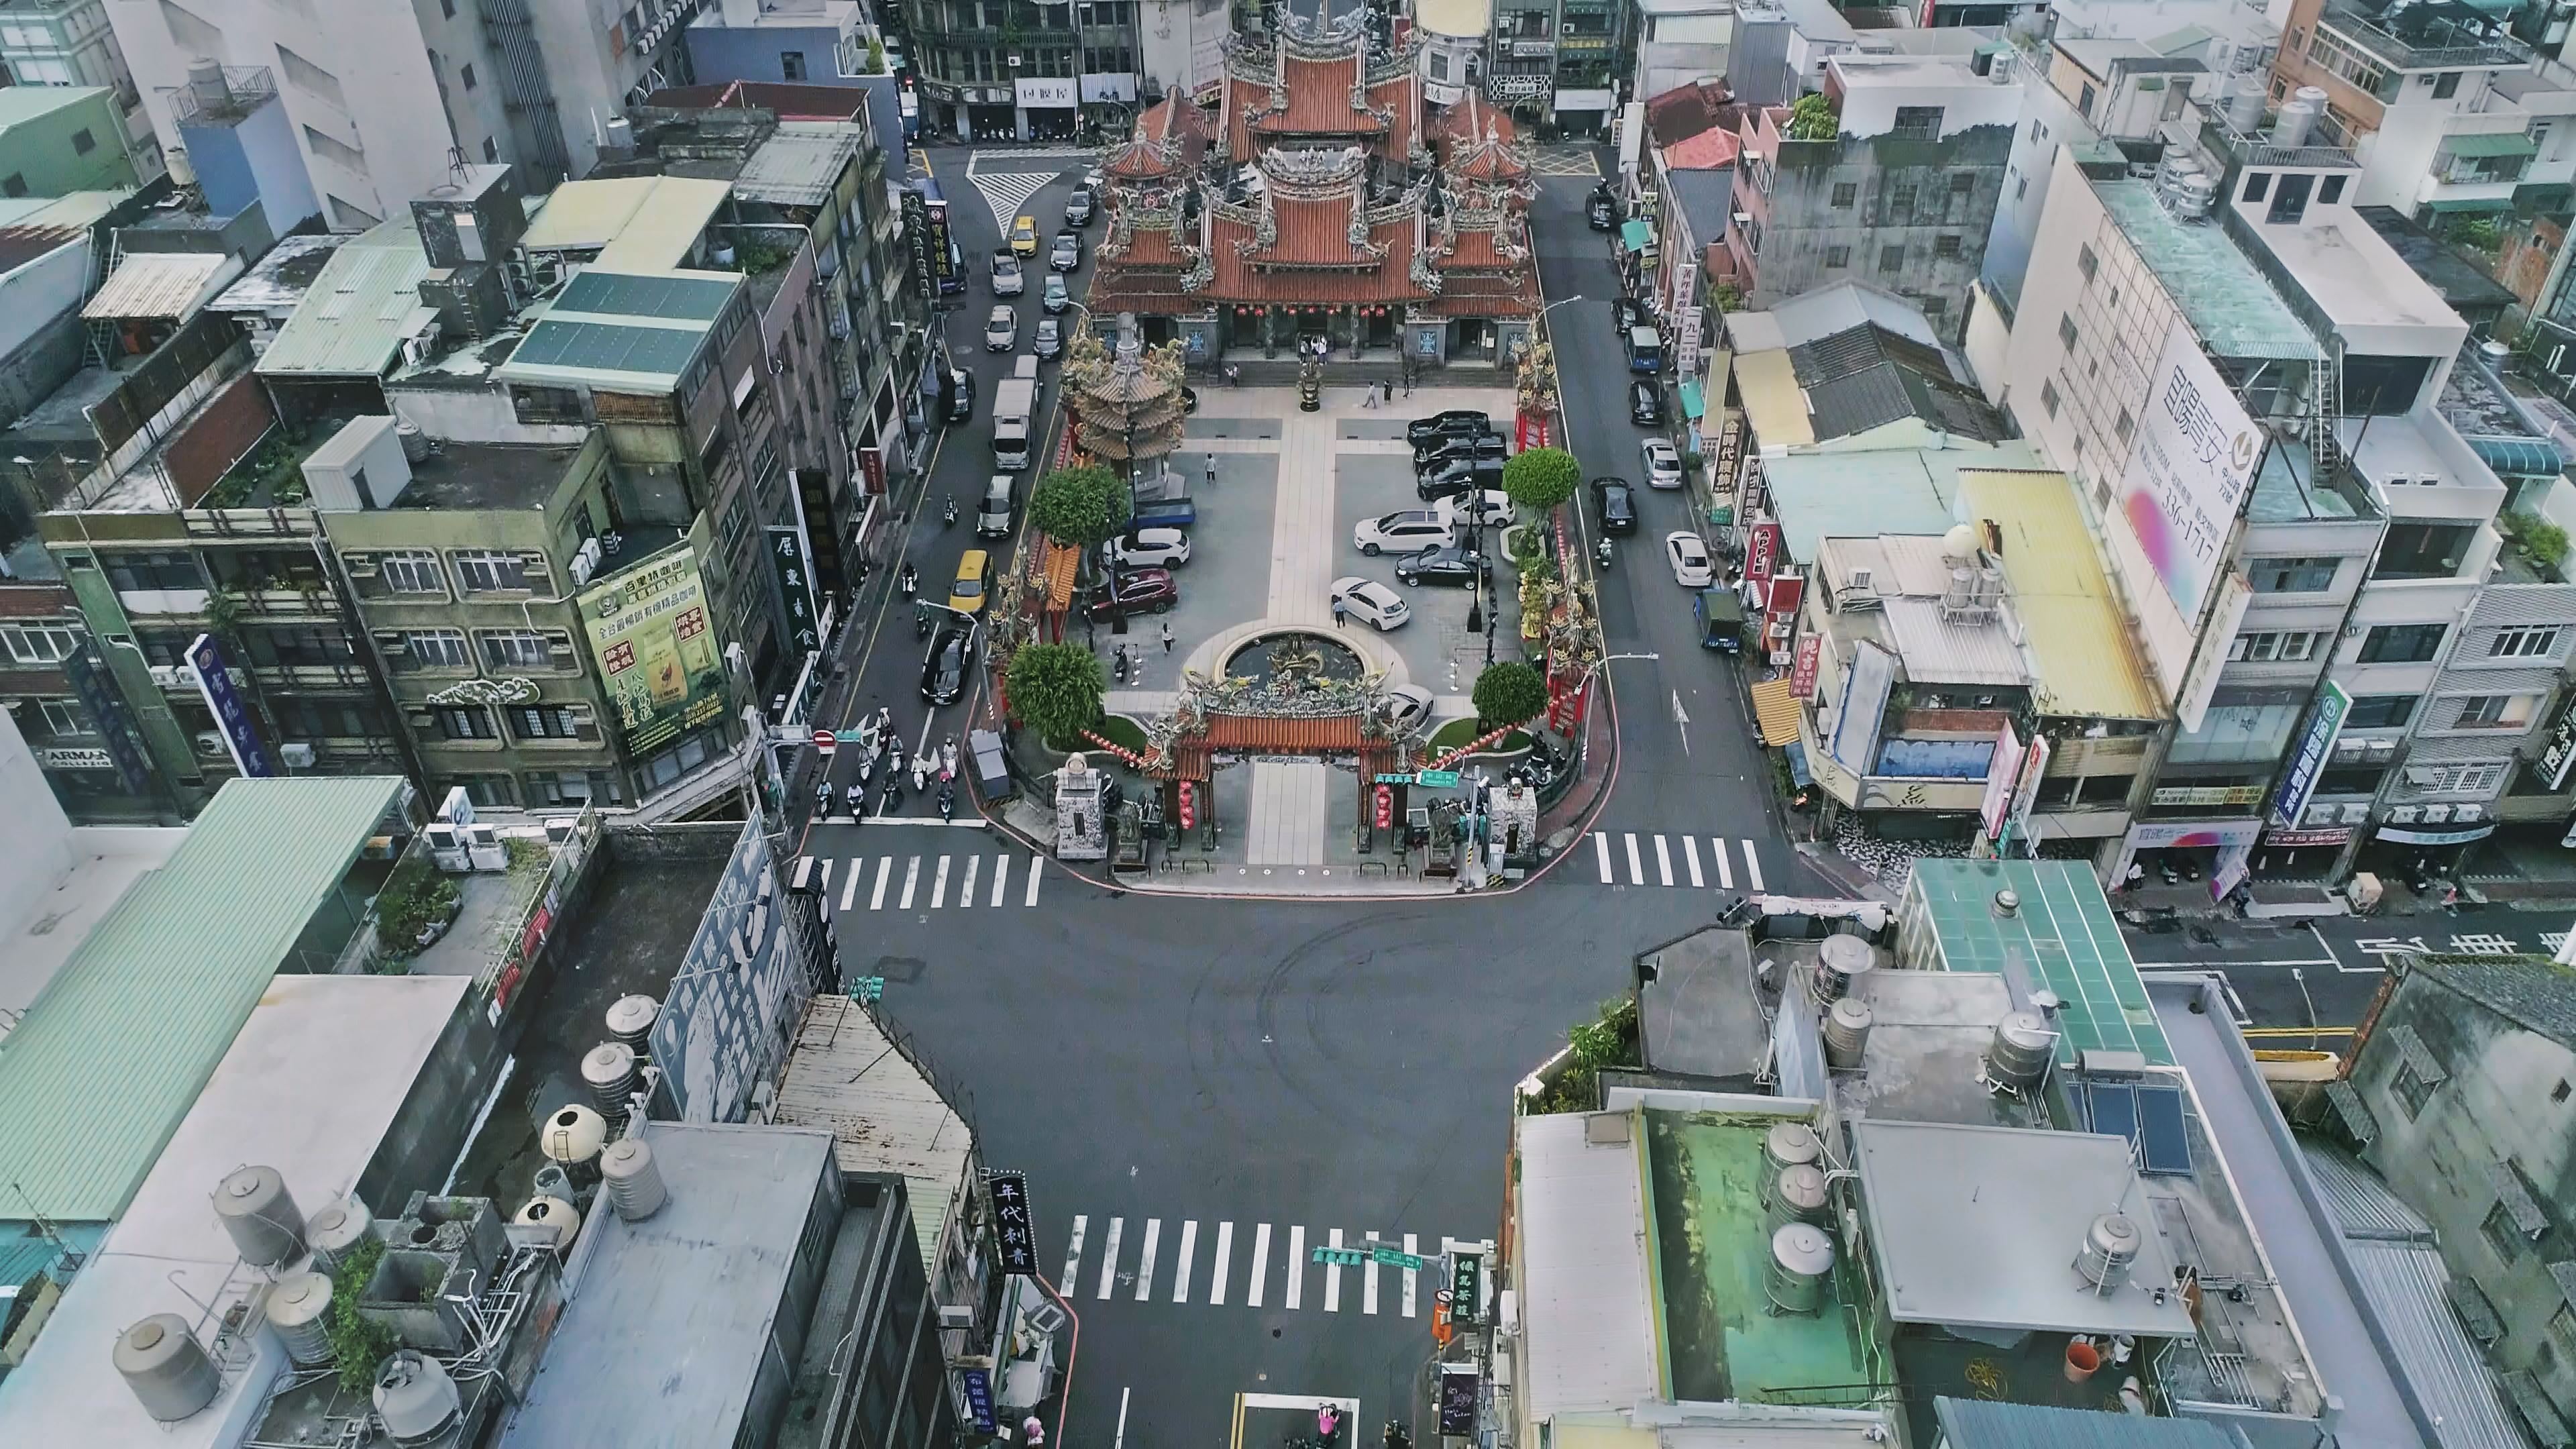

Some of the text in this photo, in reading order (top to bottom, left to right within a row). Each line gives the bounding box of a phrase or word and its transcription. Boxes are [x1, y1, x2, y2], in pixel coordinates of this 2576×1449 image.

[2222, 466, 2241, 495] 中山路
[1754, 529, 1771, 574] APPLE
[2162, 487, 2214, 566] 336-1717
[996, 1183, 1028, 1266] 年代刺青
